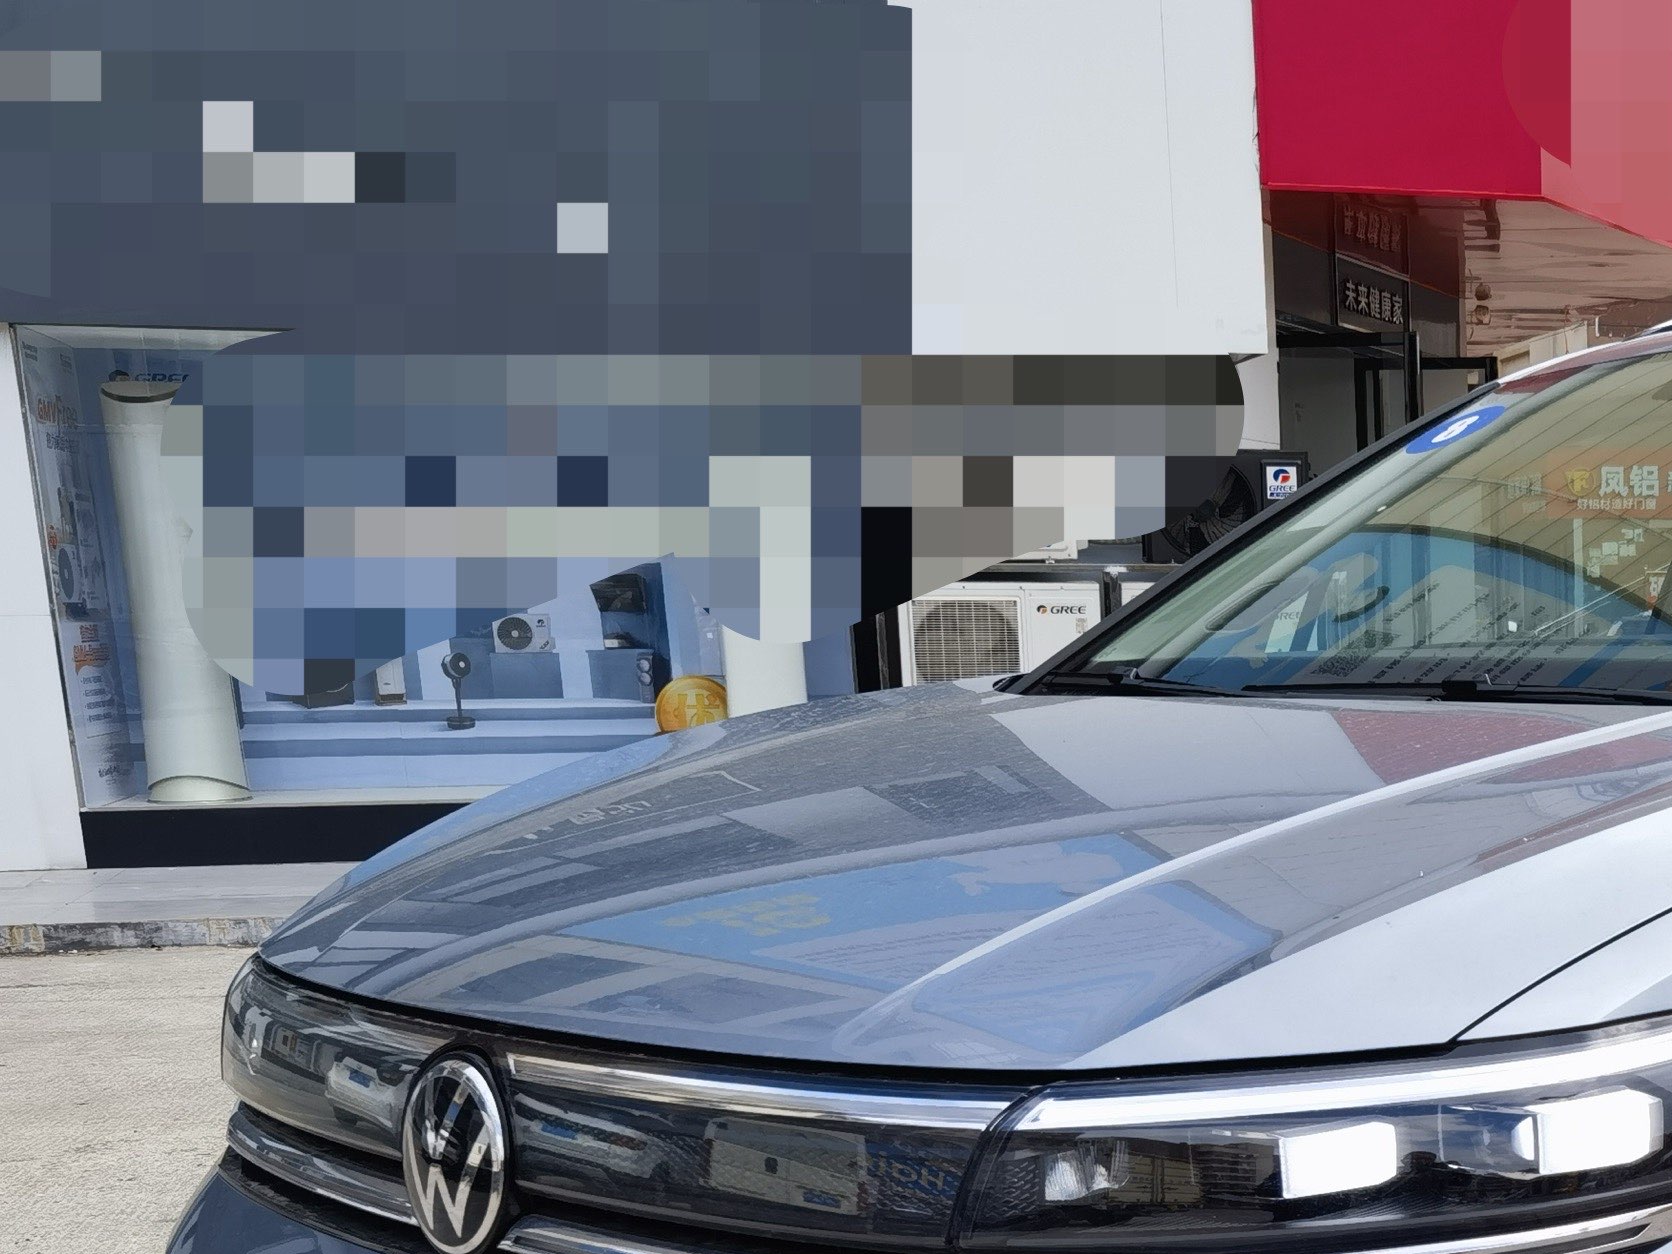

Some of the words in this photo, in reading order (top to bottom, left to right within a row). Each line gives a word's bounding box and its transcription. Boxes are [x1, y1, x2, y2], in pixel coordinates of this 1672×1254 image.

[1345, 280, 1403, 325] 未来健康家
[1599, 465, 1660, 497] 凤铝
[1050, 605, 1087, 614] GREE
